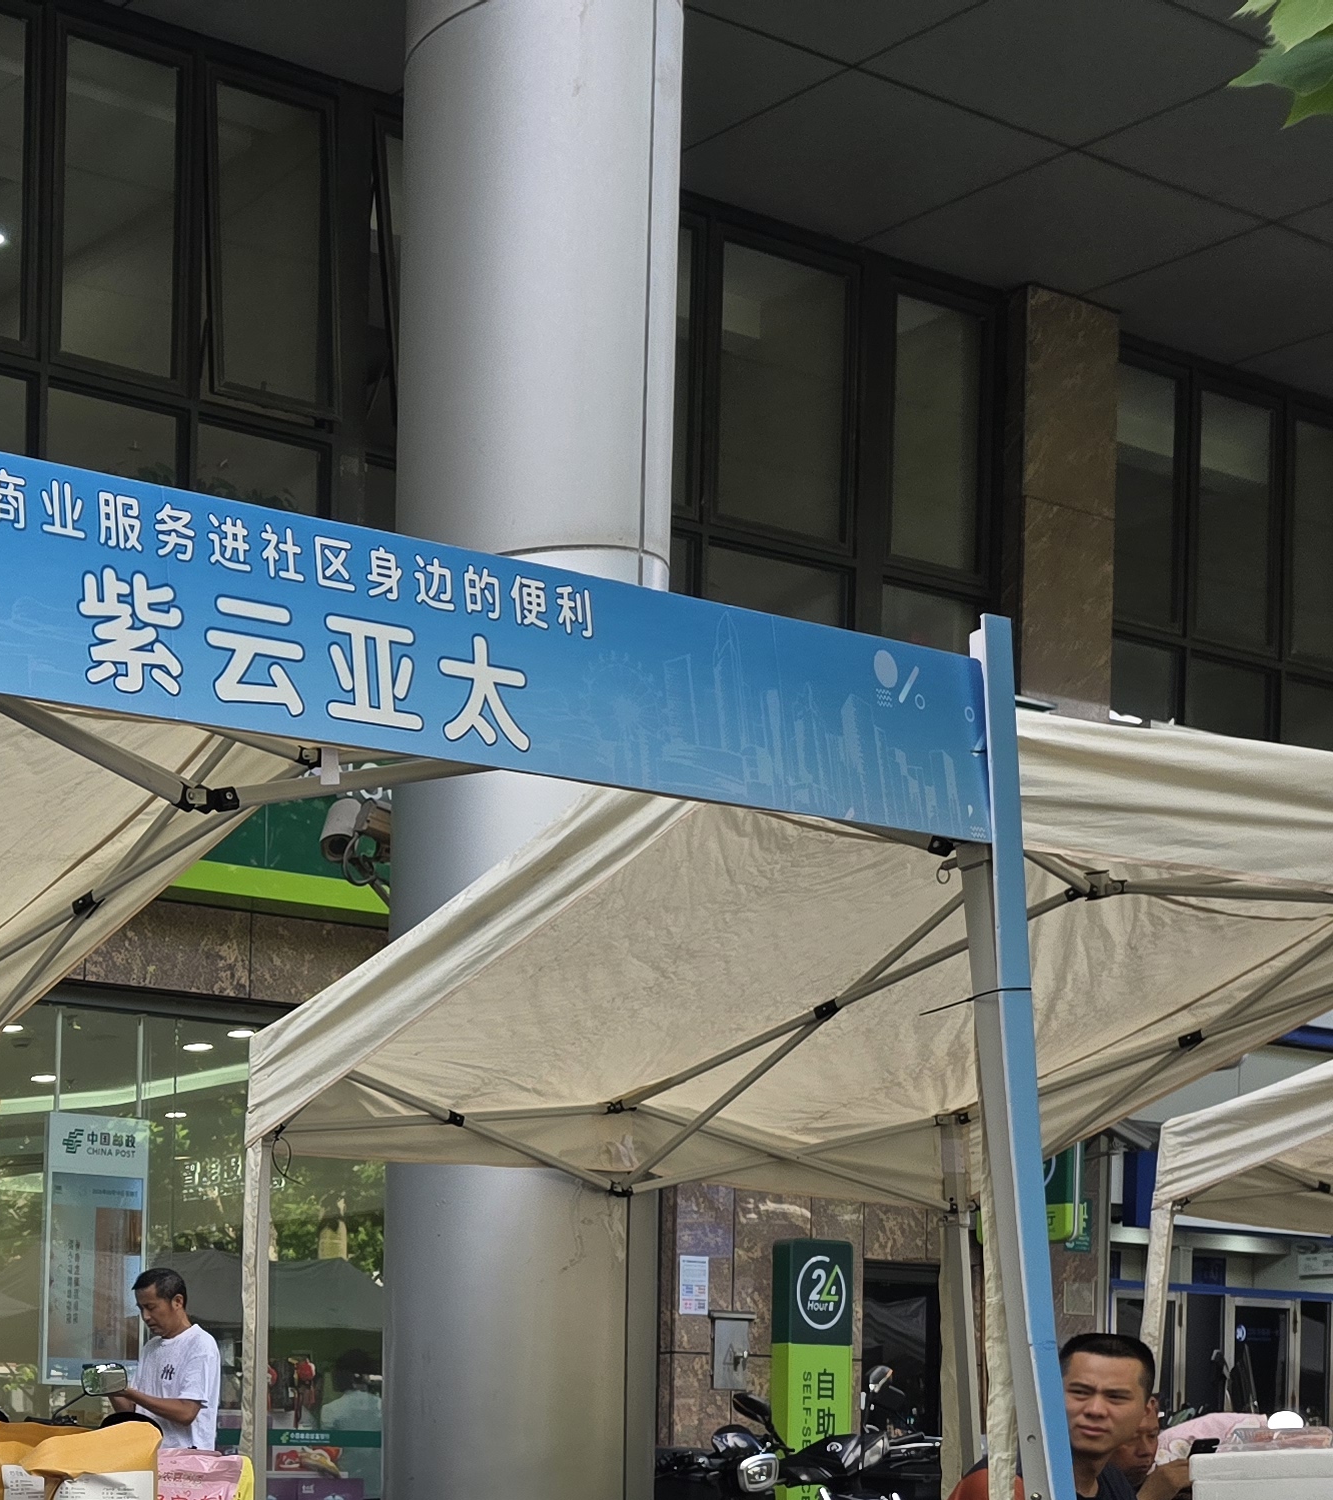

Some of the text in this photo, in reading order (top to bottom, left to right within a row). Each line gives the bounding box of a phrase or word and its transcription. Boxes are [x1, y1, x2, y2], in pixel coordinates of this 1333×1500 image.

[78, 566, 531, 752] 紫云亚太
[86, 1130, 136, 1149] 中国邮政
[86, 1146, 136, 1158] CHINA POST
[808, 1264, 839, 1301] 24
